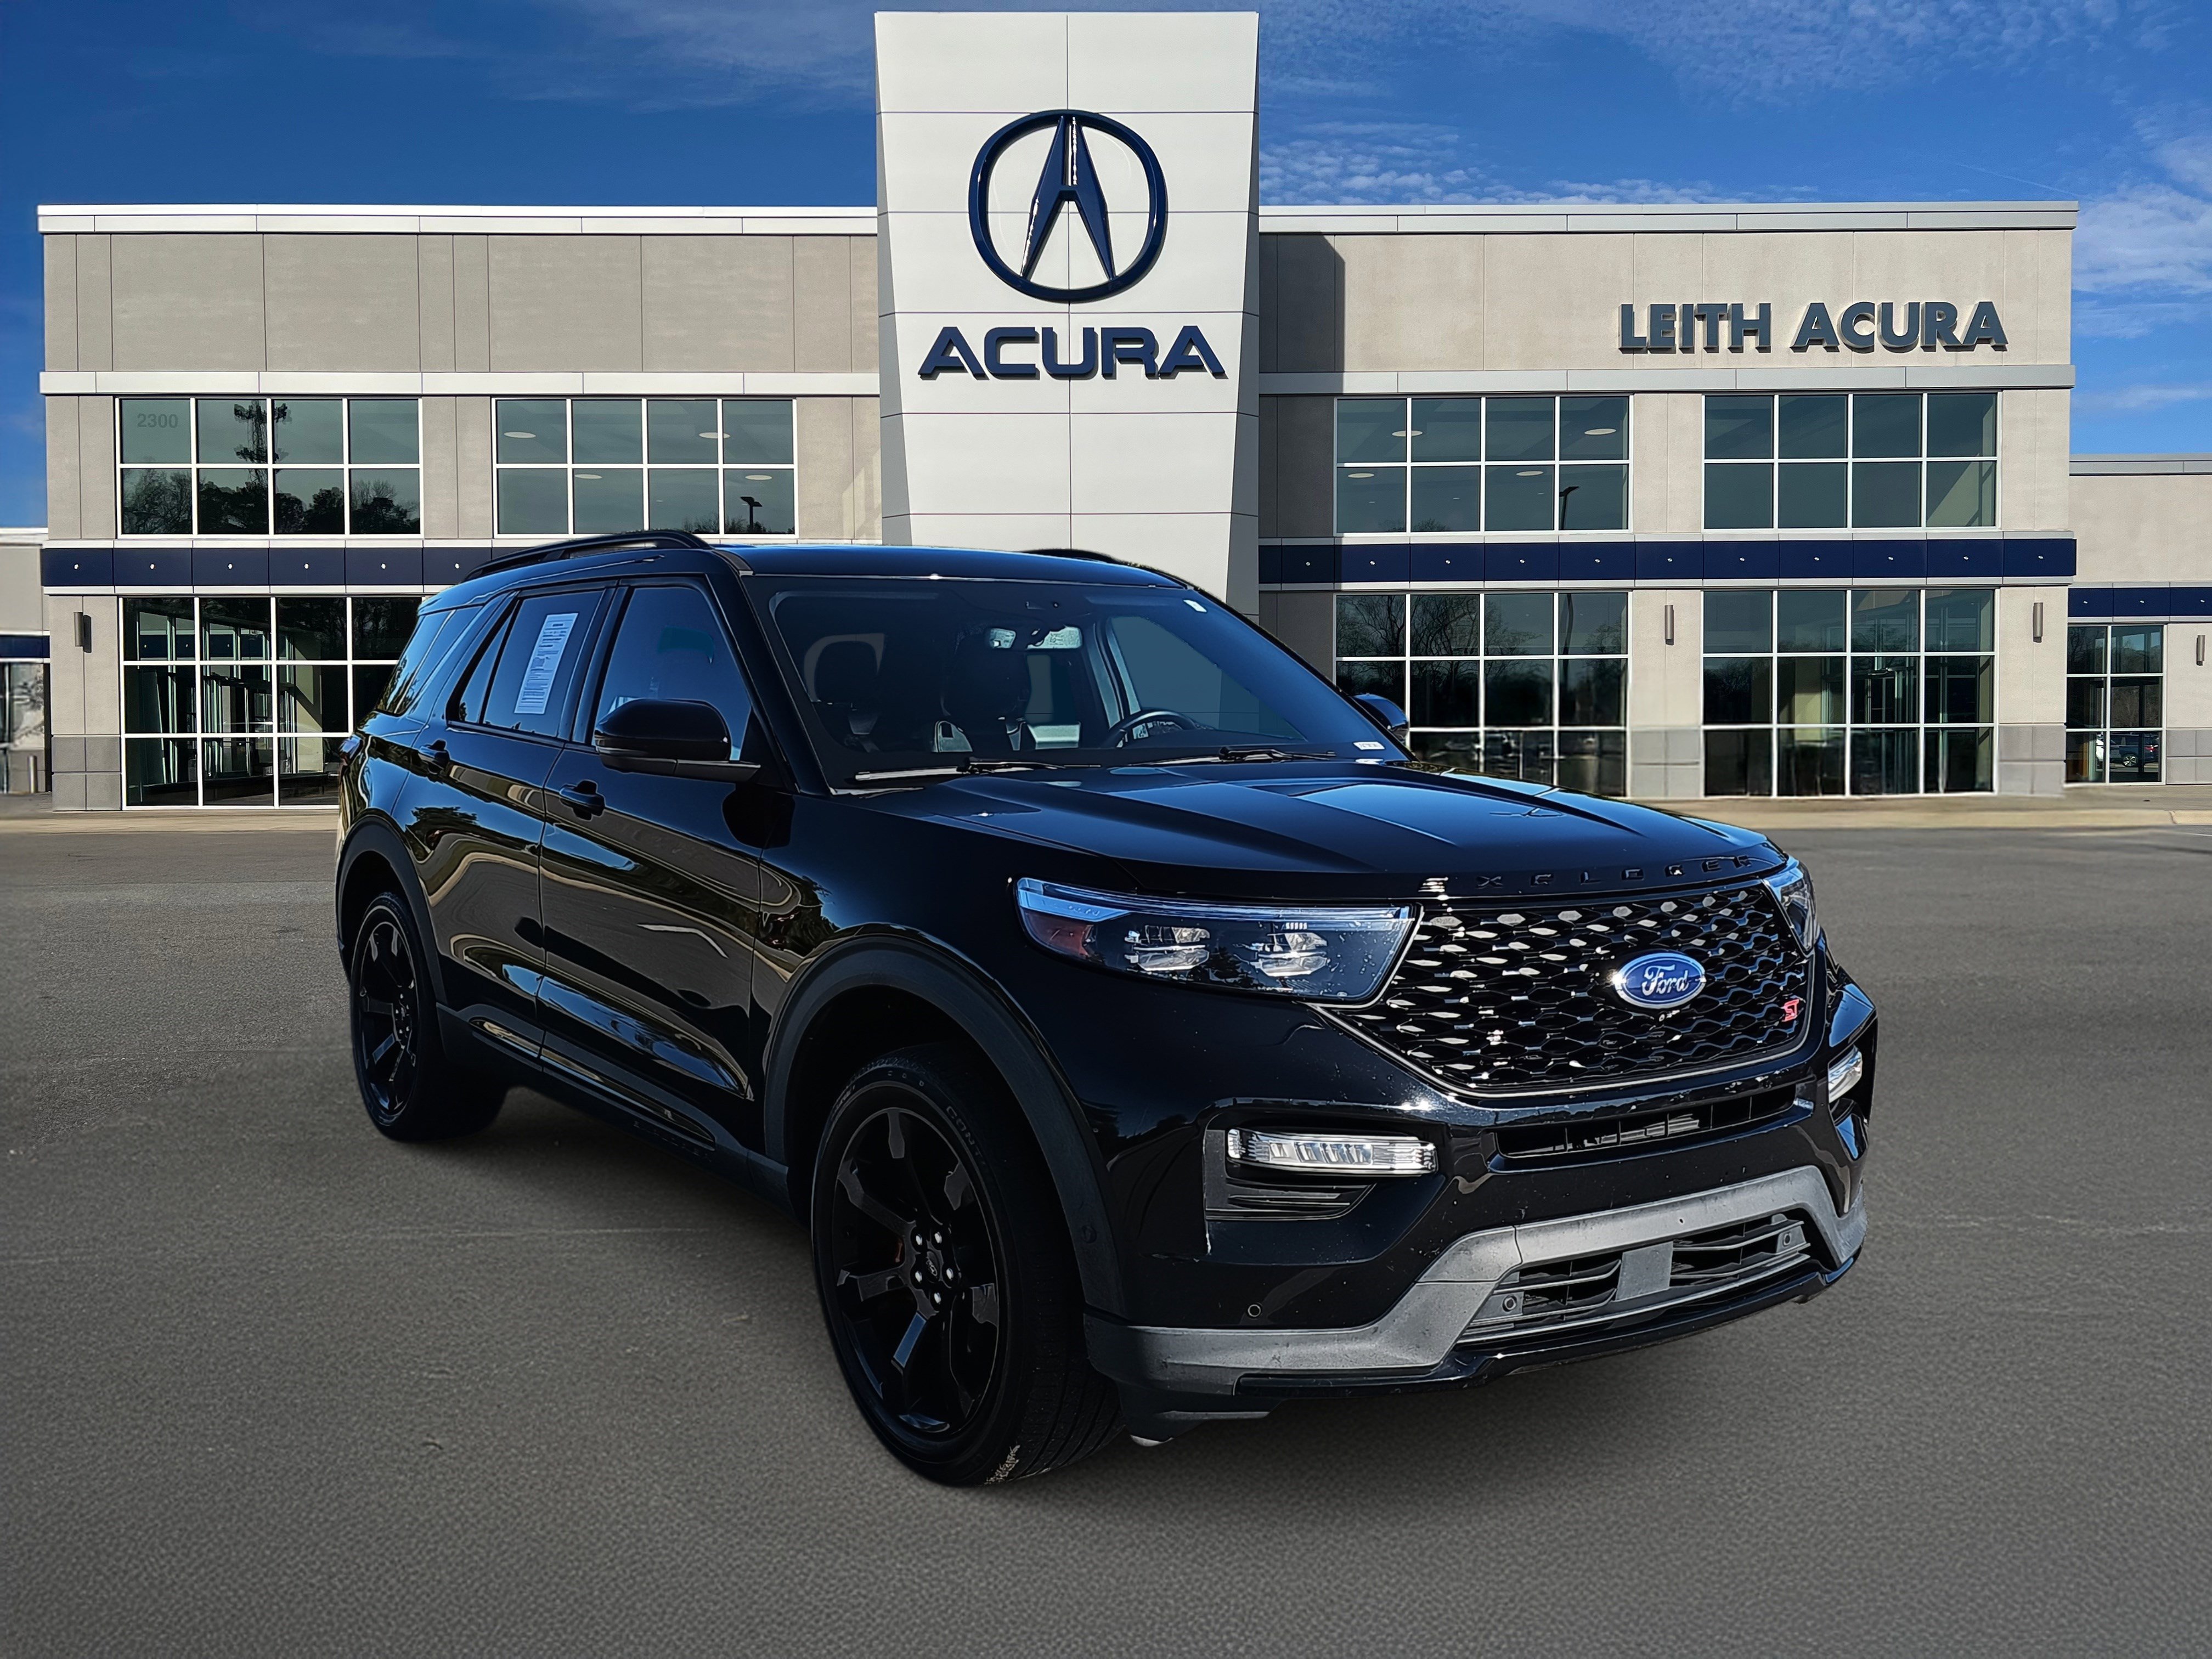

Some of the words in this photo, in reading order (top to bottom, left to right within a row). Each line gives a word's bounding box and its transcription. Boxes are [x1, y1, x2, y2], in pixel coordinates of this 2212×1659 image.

[1618, 302, 1771, 352] LEITH
[1789, 301, 2009, 353] ACURA
[917, 326, 1227, 379] ACURA
[137, 413, 178, 428] 2300
[1418, 855, 1752, 893] EXPLORER
[1641, 964, 1690, 996] Ford
